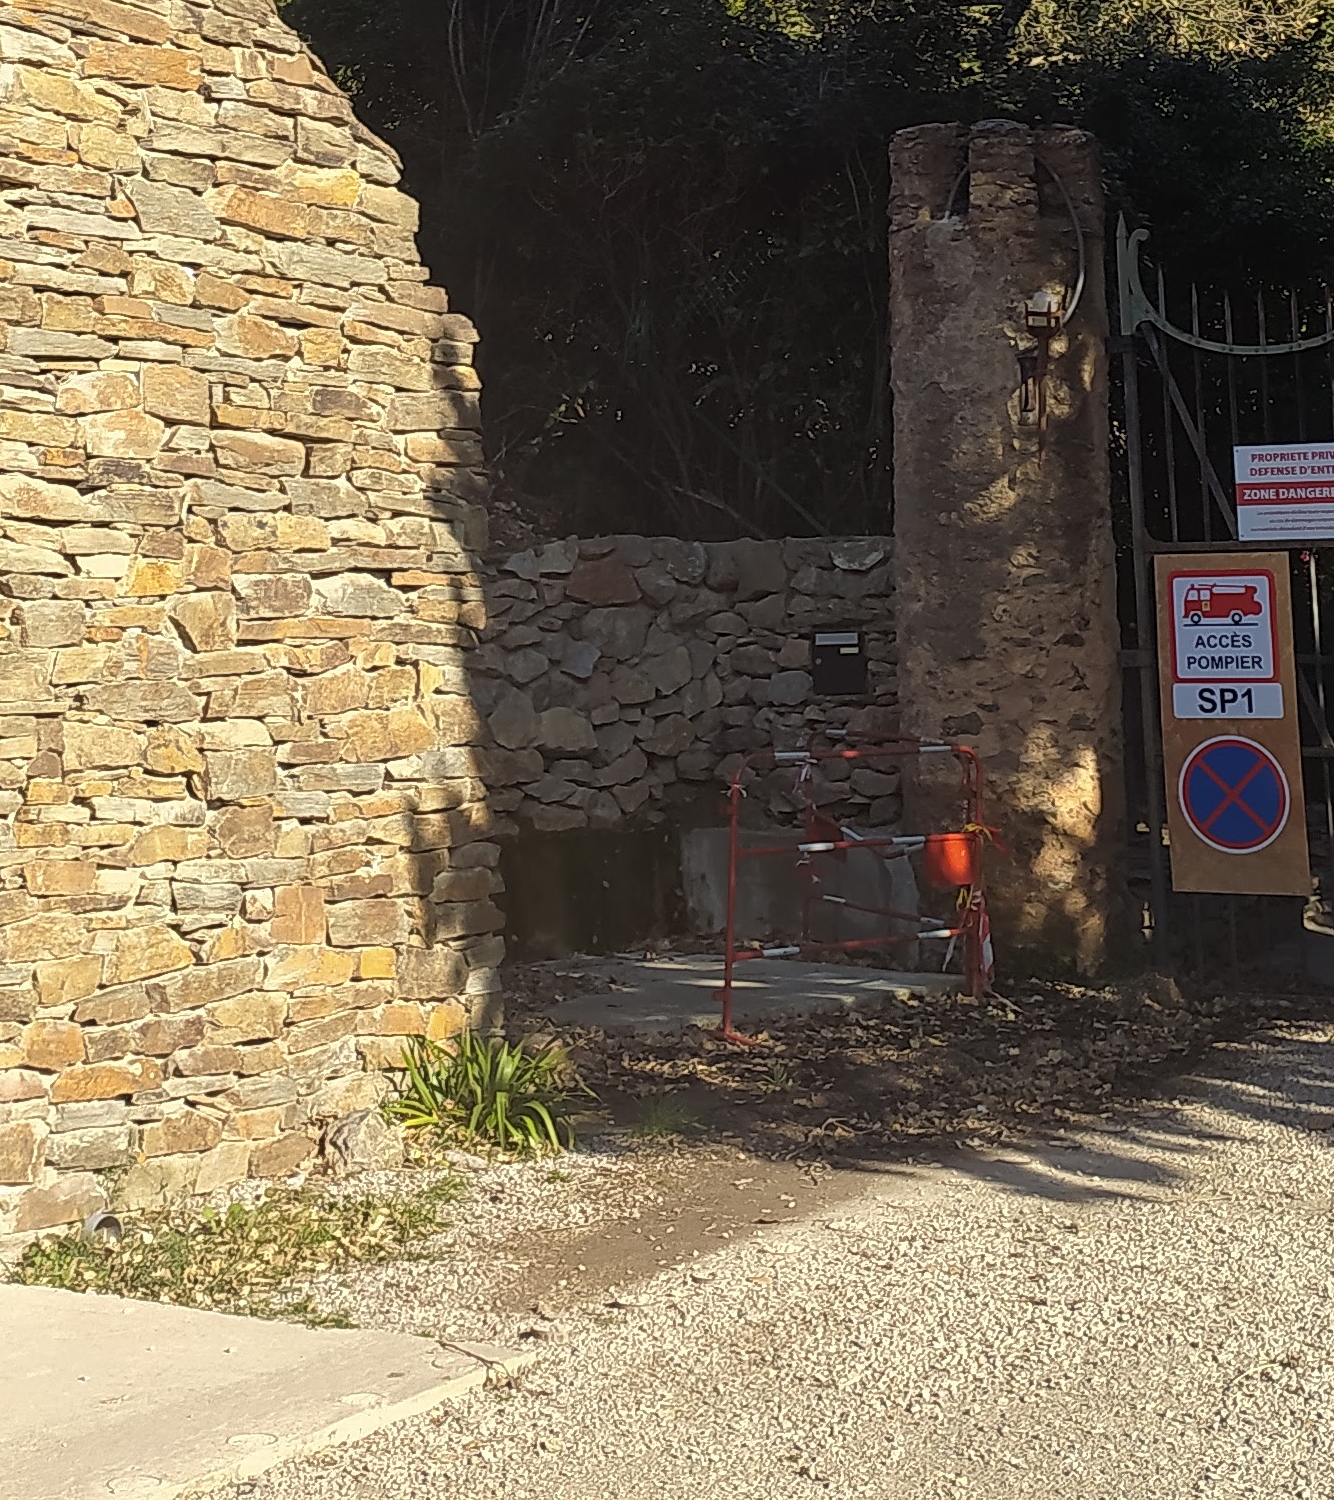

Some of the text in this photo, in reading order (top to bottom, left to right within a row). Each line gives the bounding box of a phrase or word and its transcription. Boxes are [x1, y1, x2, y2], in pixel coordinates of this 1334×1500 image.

[1250, 451, 1310, 463] PROPRIETE
[1249, 465, 1298, 477] DEFENSE
[1243, 488, 1278, 500] ZONE
[1194, 631, 1253, 649] ACCÈS
[1186, 655, 1263, 670] POMPIER
[1197, 687, 1254, 714] SP1
